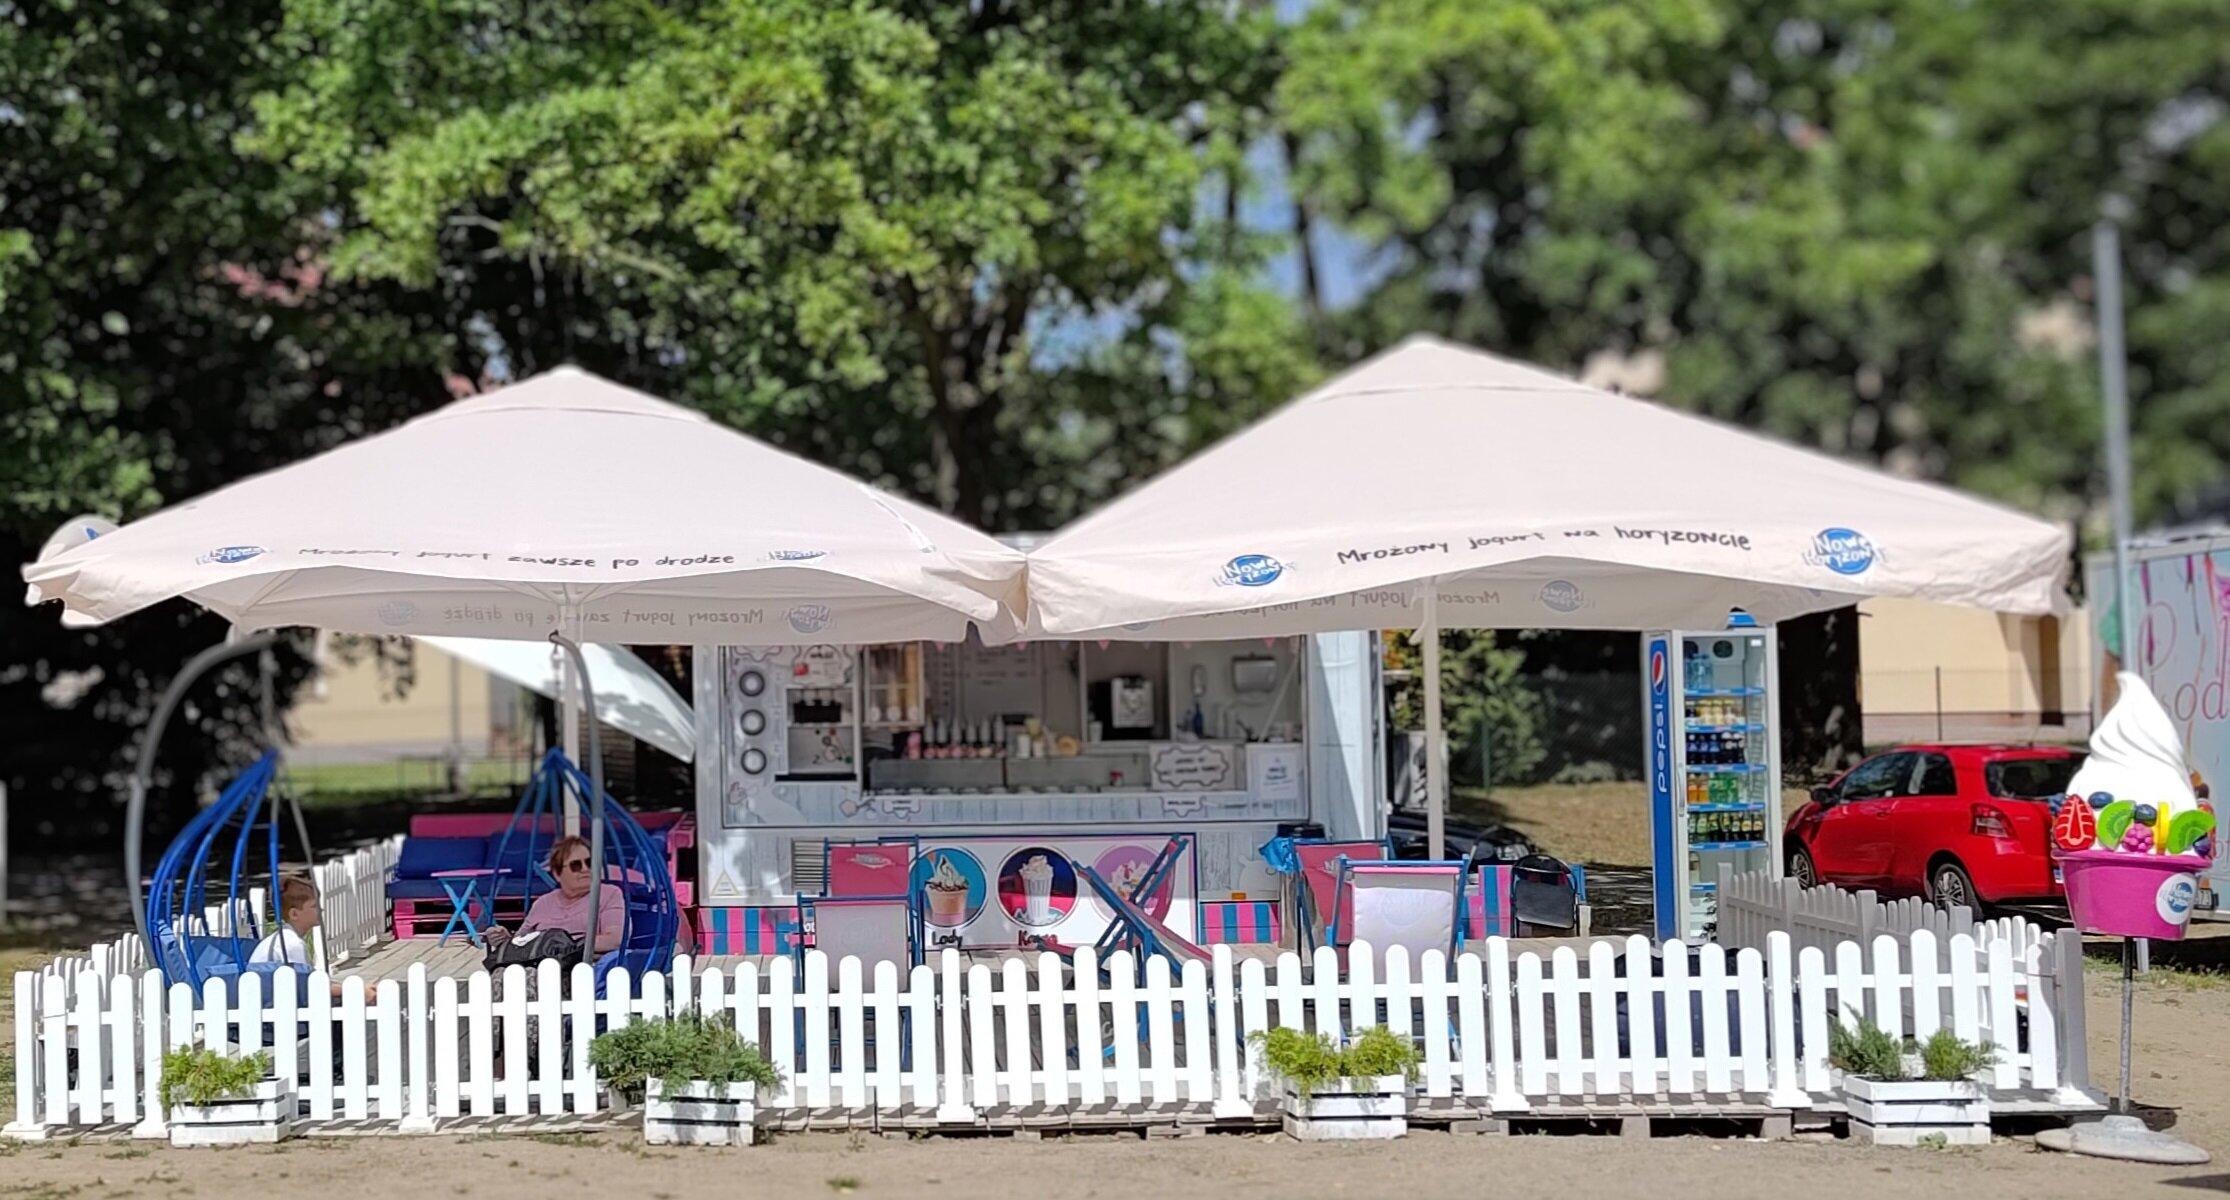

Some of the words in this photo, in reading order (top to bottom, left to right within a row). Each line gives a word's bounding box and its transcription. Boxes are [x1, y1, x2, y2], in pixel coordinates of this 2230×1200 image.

[1469, 532, 1545, 550] jogurt
[1614, 526, 1752, 550] horyzoncie
[507, 554, 596, 568] zawsze
[612, 559, 640, 570] po
[655, 553, 736, 567] drodze
[1653, 703, 1668, 793] pepsi
